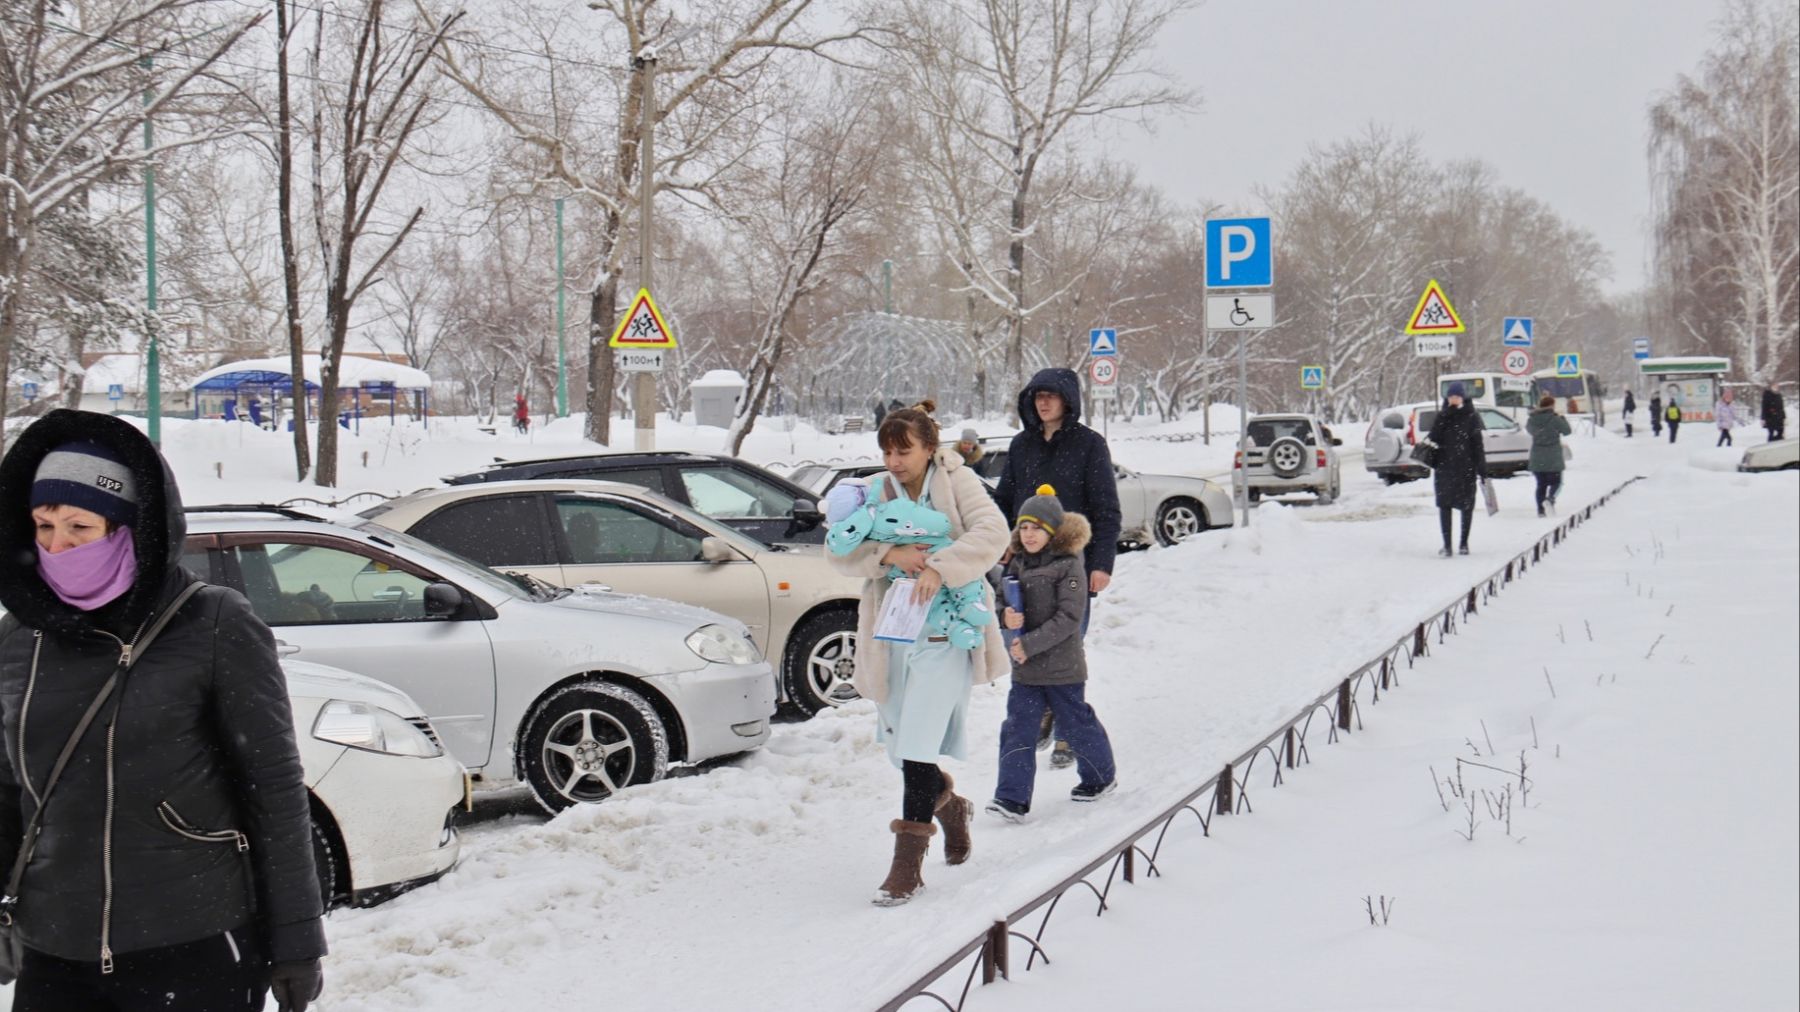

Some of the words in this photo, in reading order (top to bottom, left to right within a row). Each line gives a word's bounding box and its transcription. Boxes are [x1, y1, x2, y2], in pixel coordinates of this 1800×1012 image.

[1221, 225, 1256, 280] P
[630, 355, 654, 365] 100м
[1508, 356, 1526, 368] 20
[1096, 365, 1111, 377] 20
